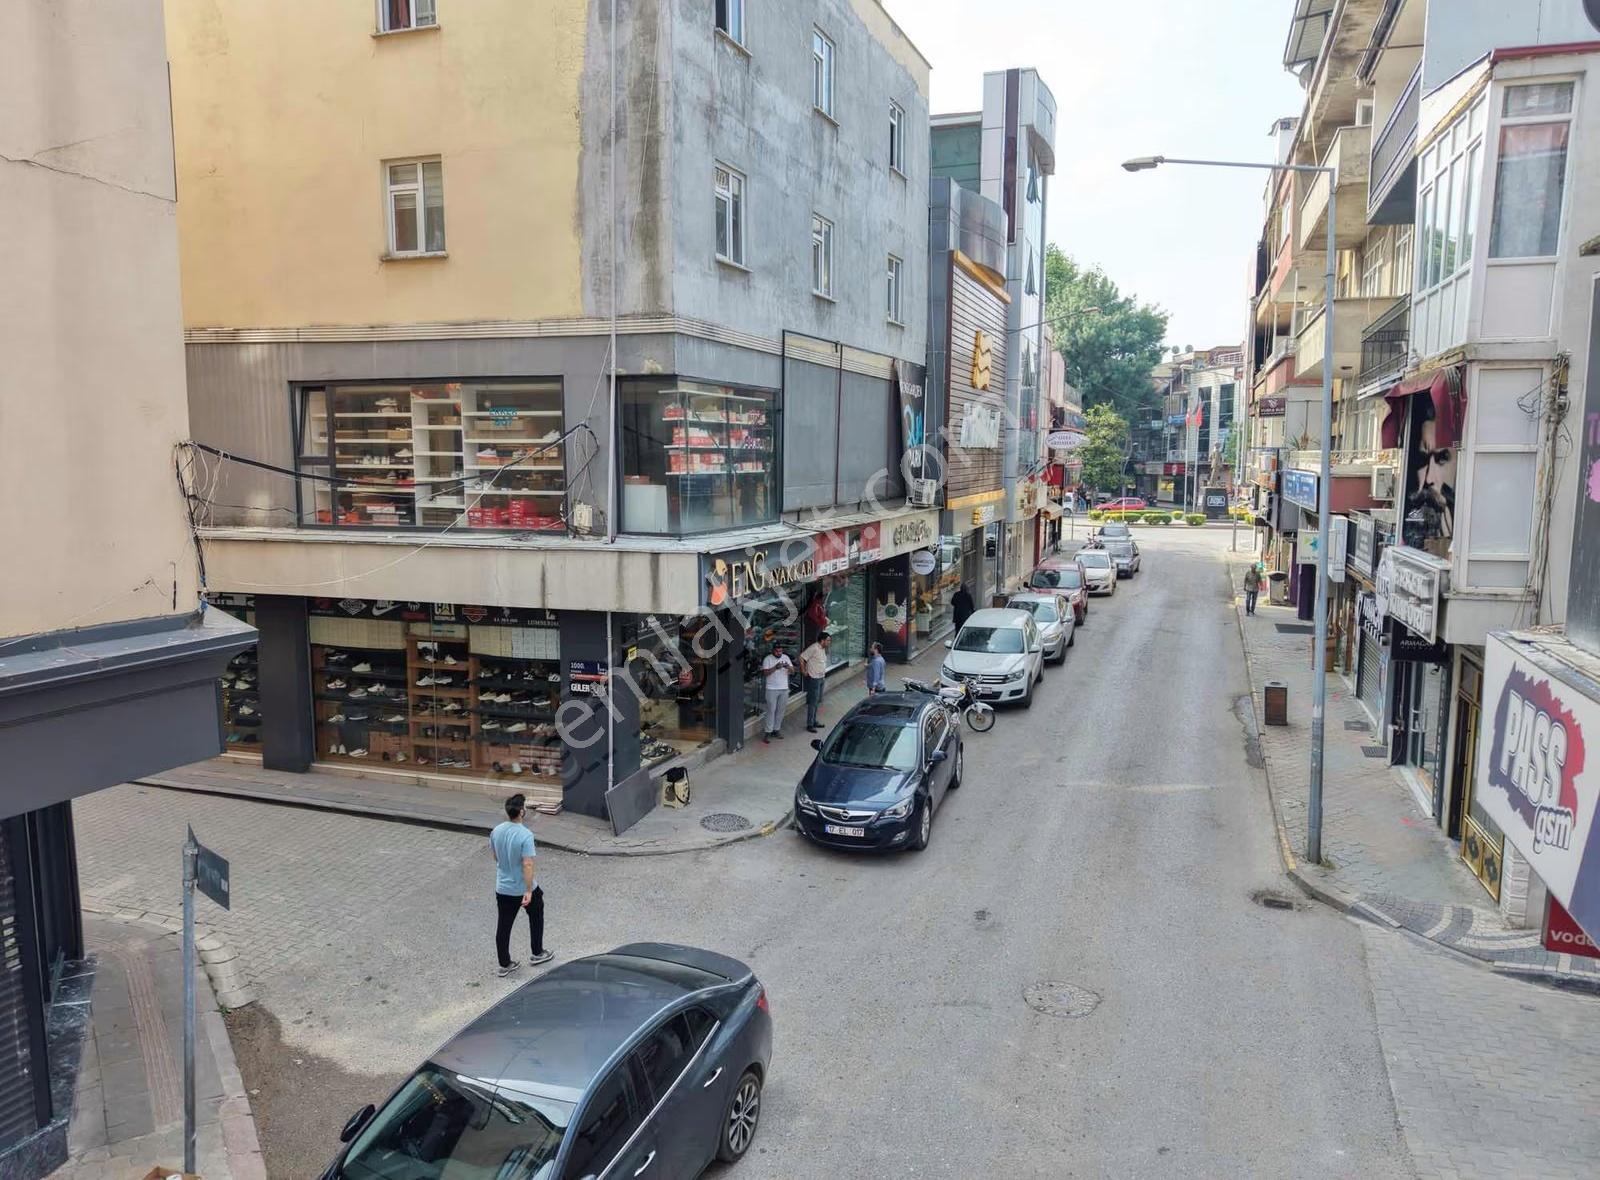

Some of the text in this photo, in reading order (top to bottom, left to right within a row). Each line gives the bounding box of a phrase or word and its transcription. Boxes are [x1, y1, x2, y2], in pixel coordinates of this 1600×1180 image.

[769, 559, 816, 589] AYAKKABI
[1500, 689, 1567, 808] PASS
[1533, 806, 1574, 854] gsm
